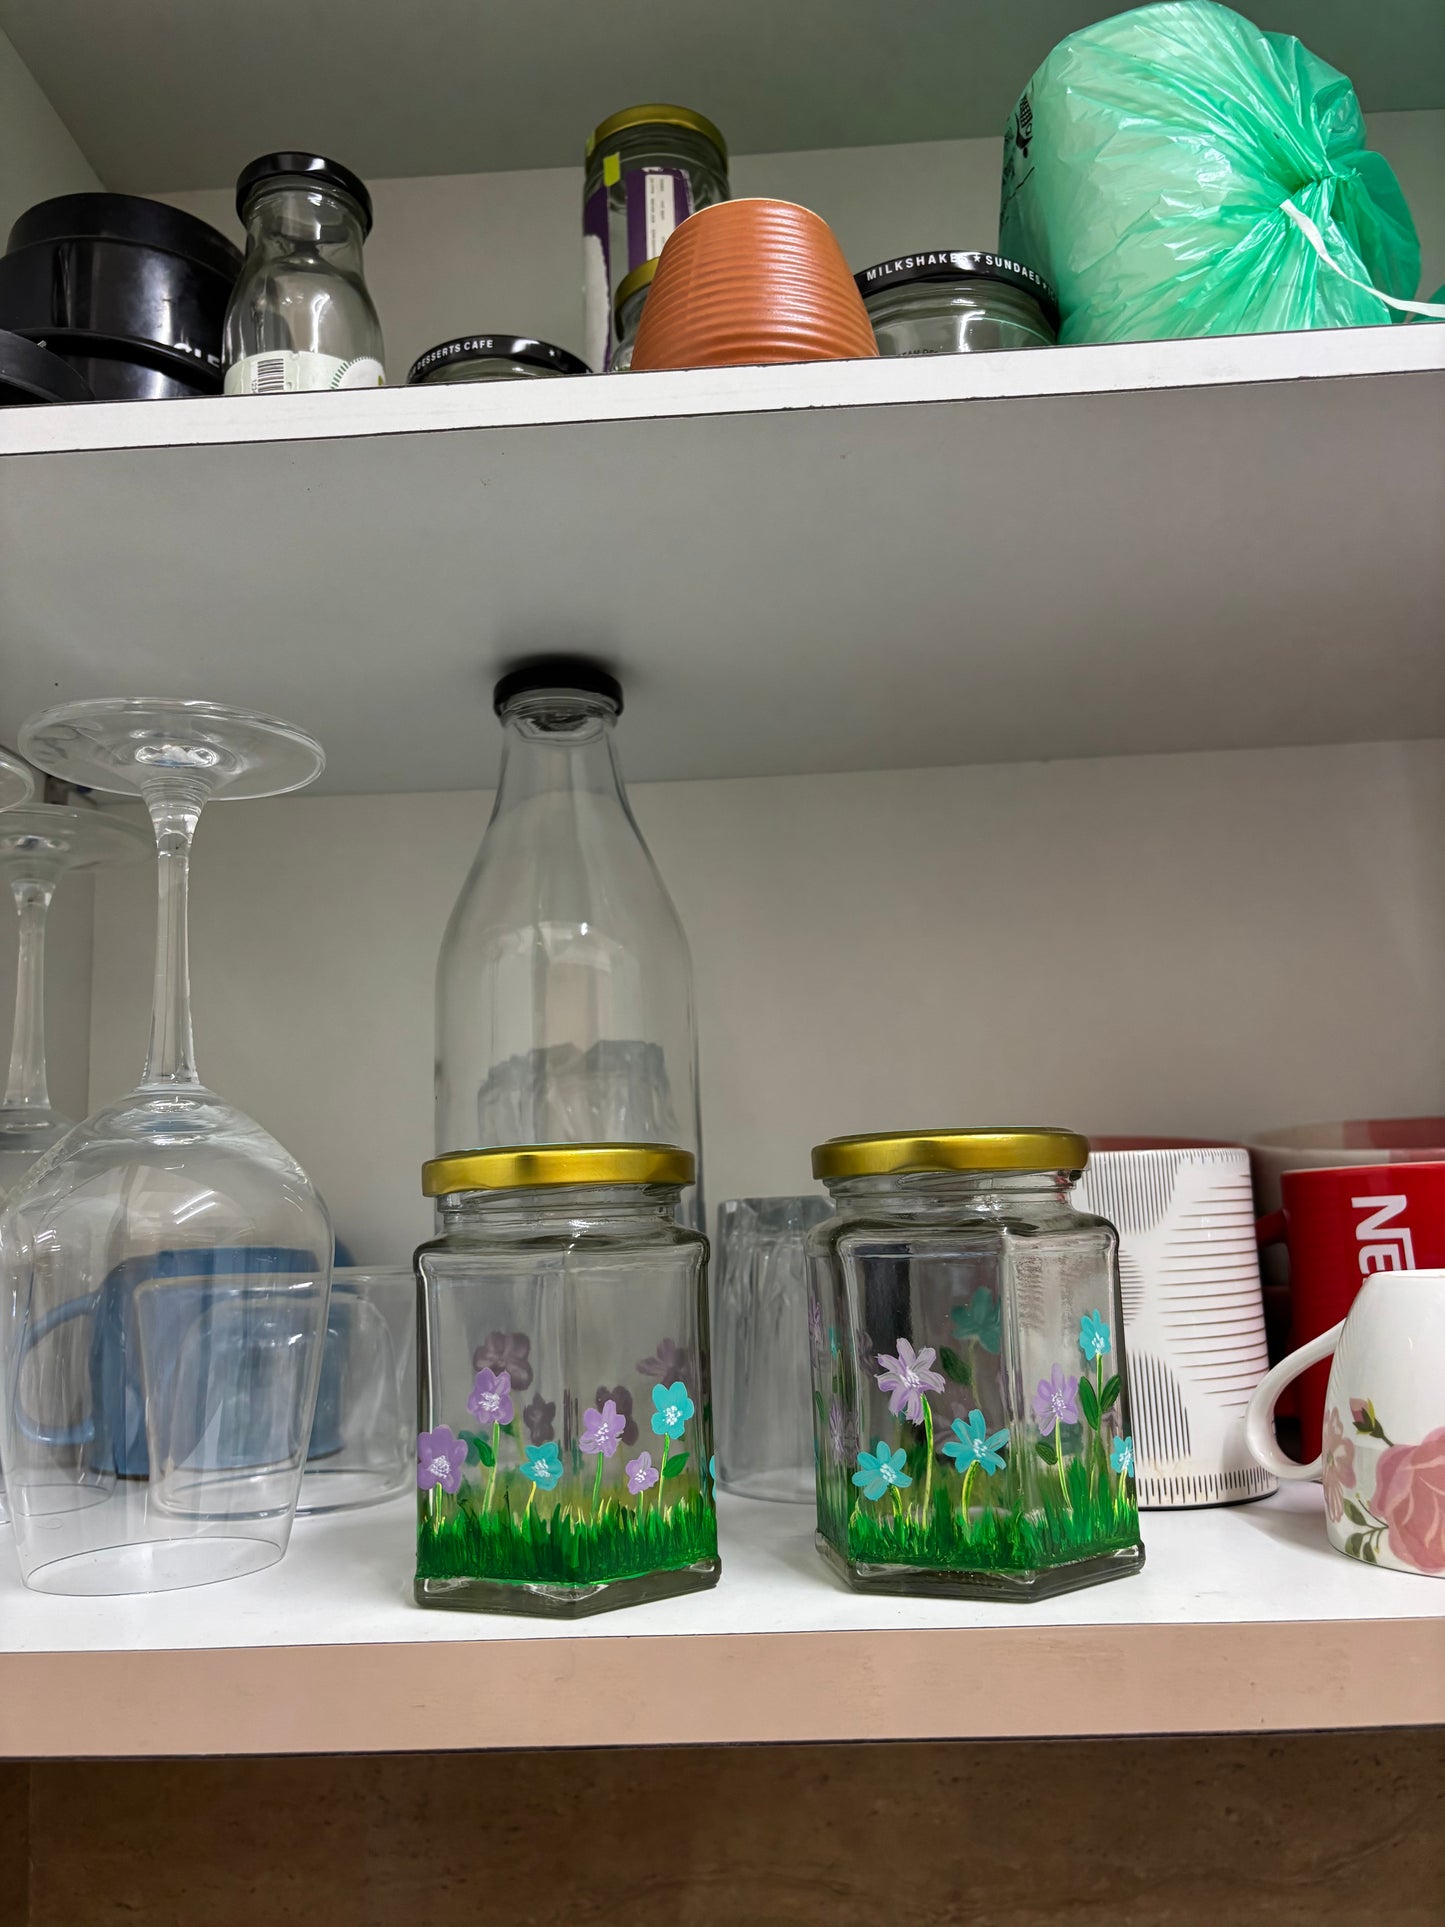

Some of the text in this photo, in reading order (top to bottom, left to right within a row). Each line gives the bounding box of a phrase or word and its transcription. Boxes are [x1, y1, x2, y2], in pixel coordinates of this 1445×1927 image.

[985, 254, 1041, 285] SUNDAES
[416, 339, 494, 370] DESSERTS CAFE
[1351, 1194, 1416, 1284] NE
